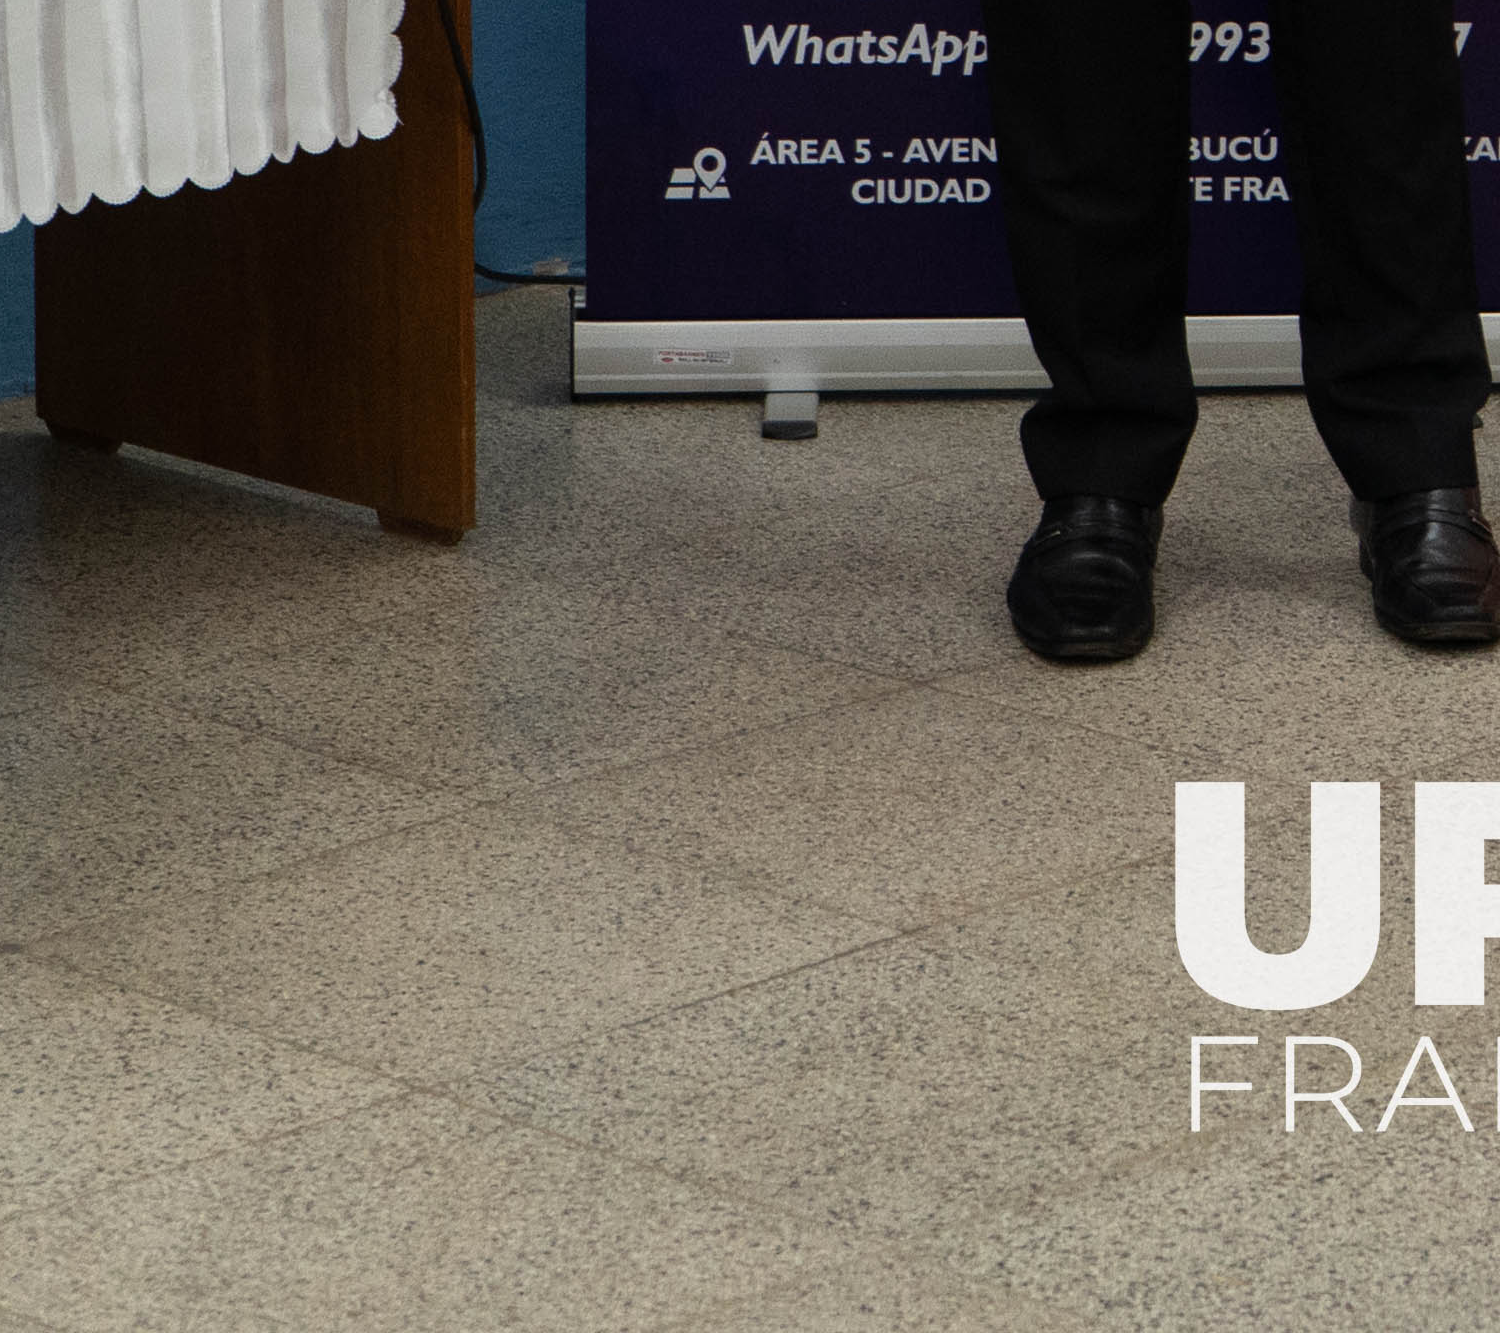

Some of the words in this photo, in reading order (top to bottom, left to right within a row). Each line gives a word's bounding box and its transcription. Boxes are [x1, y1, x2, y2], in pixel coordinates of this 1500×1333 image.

[751, 132, 844, 164] ÁREA
[855, 139, 871, 163] 5
[903, 138, 997, 163] AVEN
[852, 179, 990, 203] CIUDAD
